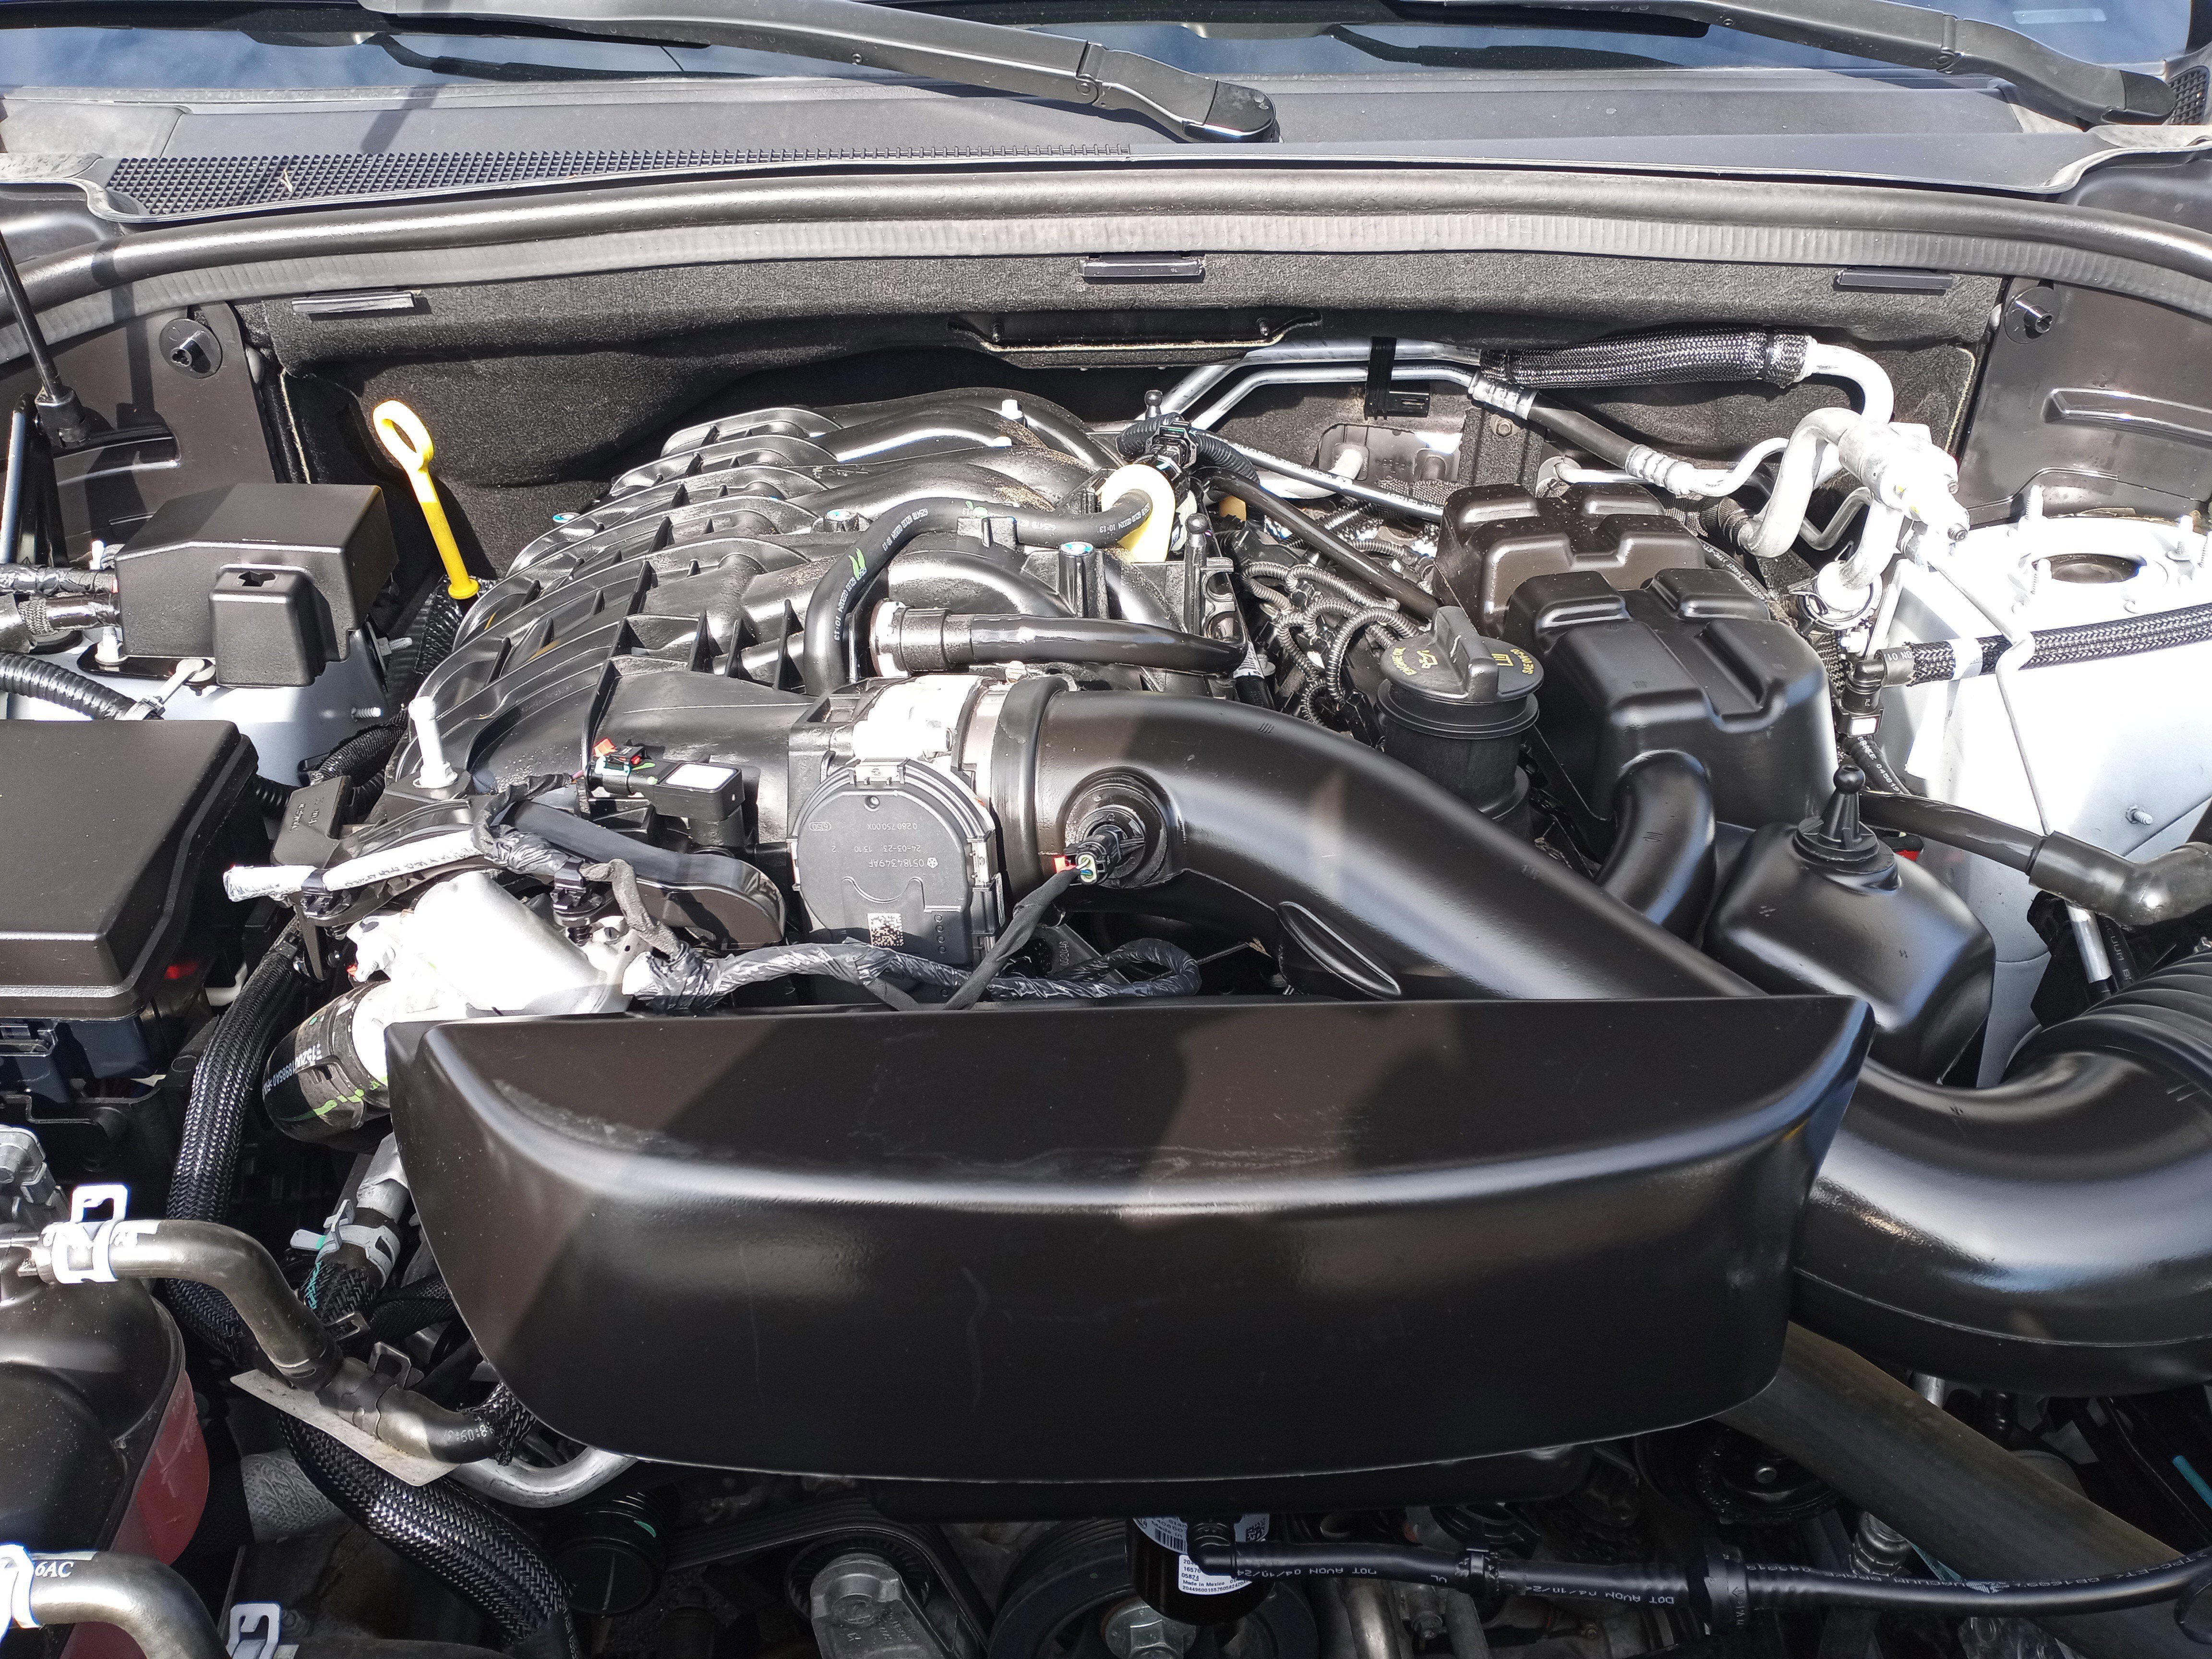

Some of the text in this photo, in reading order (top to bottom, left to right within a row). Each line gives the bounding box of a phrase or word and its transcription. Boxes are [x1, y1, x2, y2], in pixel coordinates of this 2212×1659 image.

[1392, 647, 1417, 675] ENGINE OIL
[1510, 649, 1534, 674] SAE 0W-20
[1857, 736, 1877, 760] BRAKE
[868, 858, 924, 868] 05184349AF
[1649, 1596, 1674, 1605] DOT
